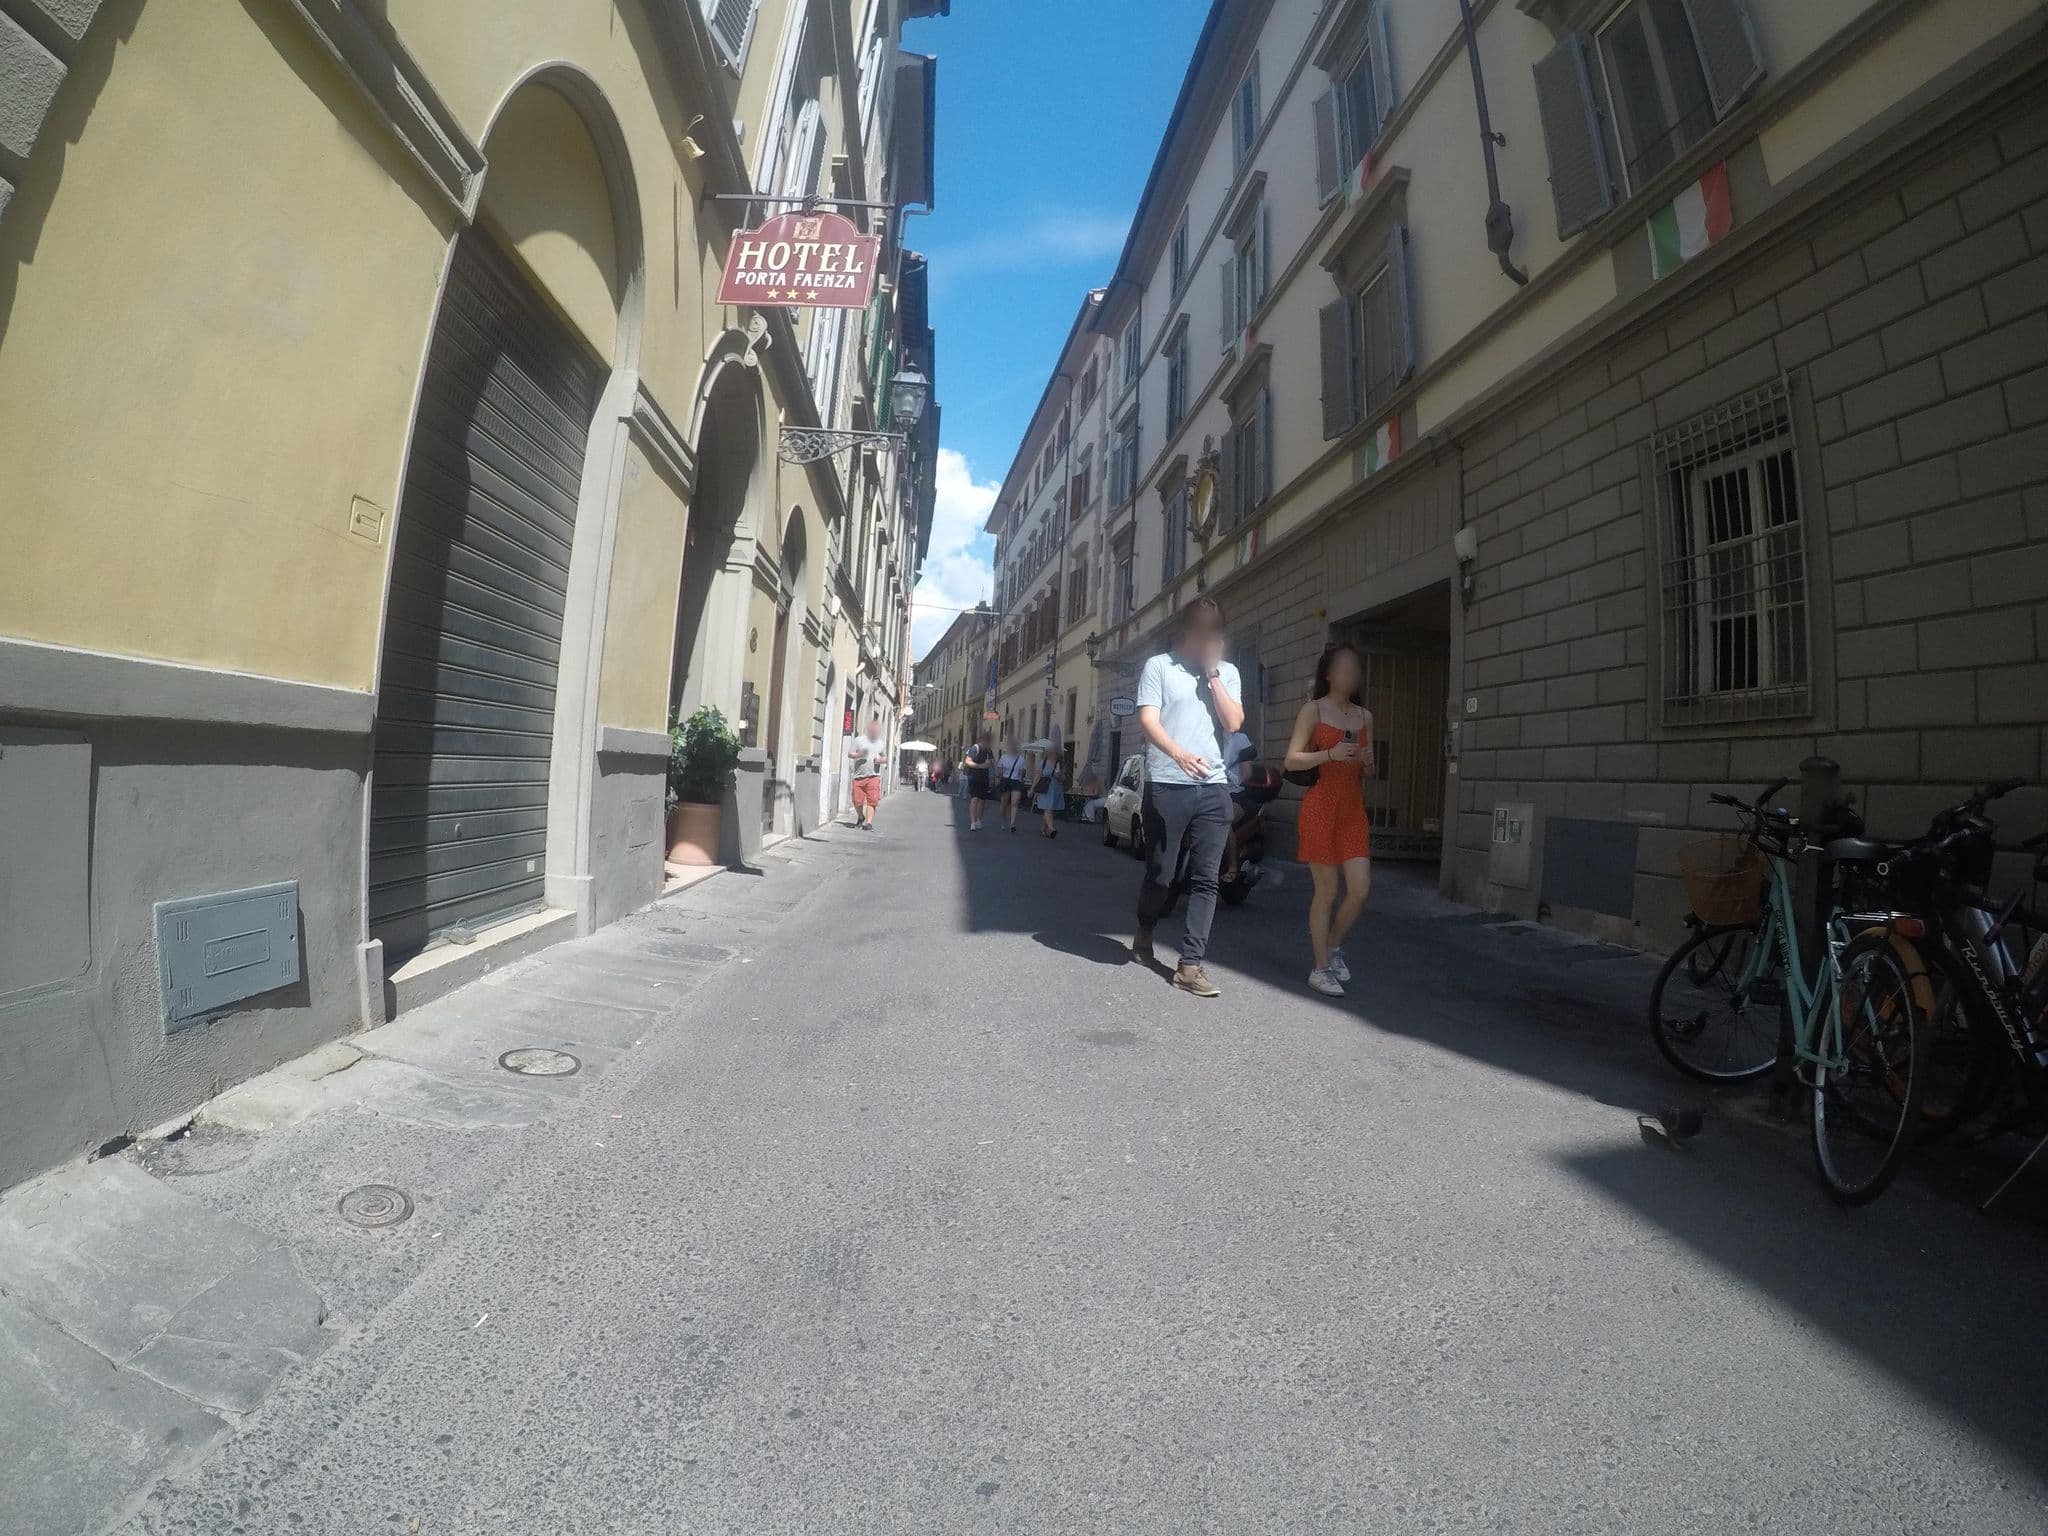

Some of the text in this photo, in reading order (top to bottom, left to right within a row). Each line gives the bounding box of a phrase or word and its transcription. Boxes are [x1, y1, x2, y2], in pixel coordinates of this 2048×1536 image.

[736, 241, 864, 274] HOTEL
[734, 271, 856, 289] PORTA FAENZA
[1960, 938, 2026, 1065] Runaway
